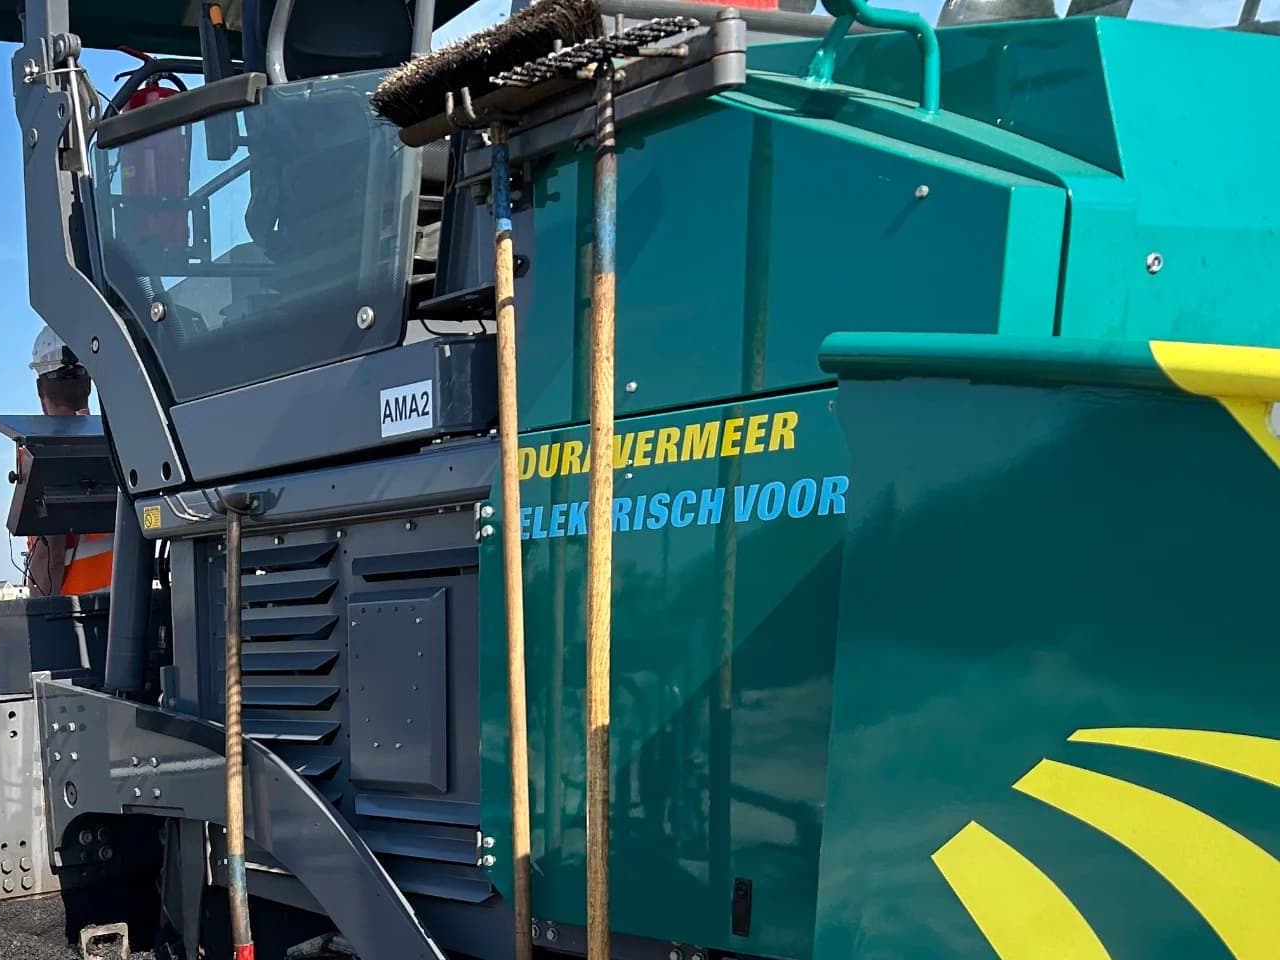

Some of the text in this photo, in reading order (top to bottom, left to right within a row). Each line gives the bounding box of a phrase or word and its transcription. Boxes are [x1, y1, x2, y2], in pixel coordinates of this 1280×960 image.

[382, 391, 430, 425] AMA2
[612, 411, 799, 470] VERMEER
[520, 475, 850, 540] ELEKRISCH VOOR
